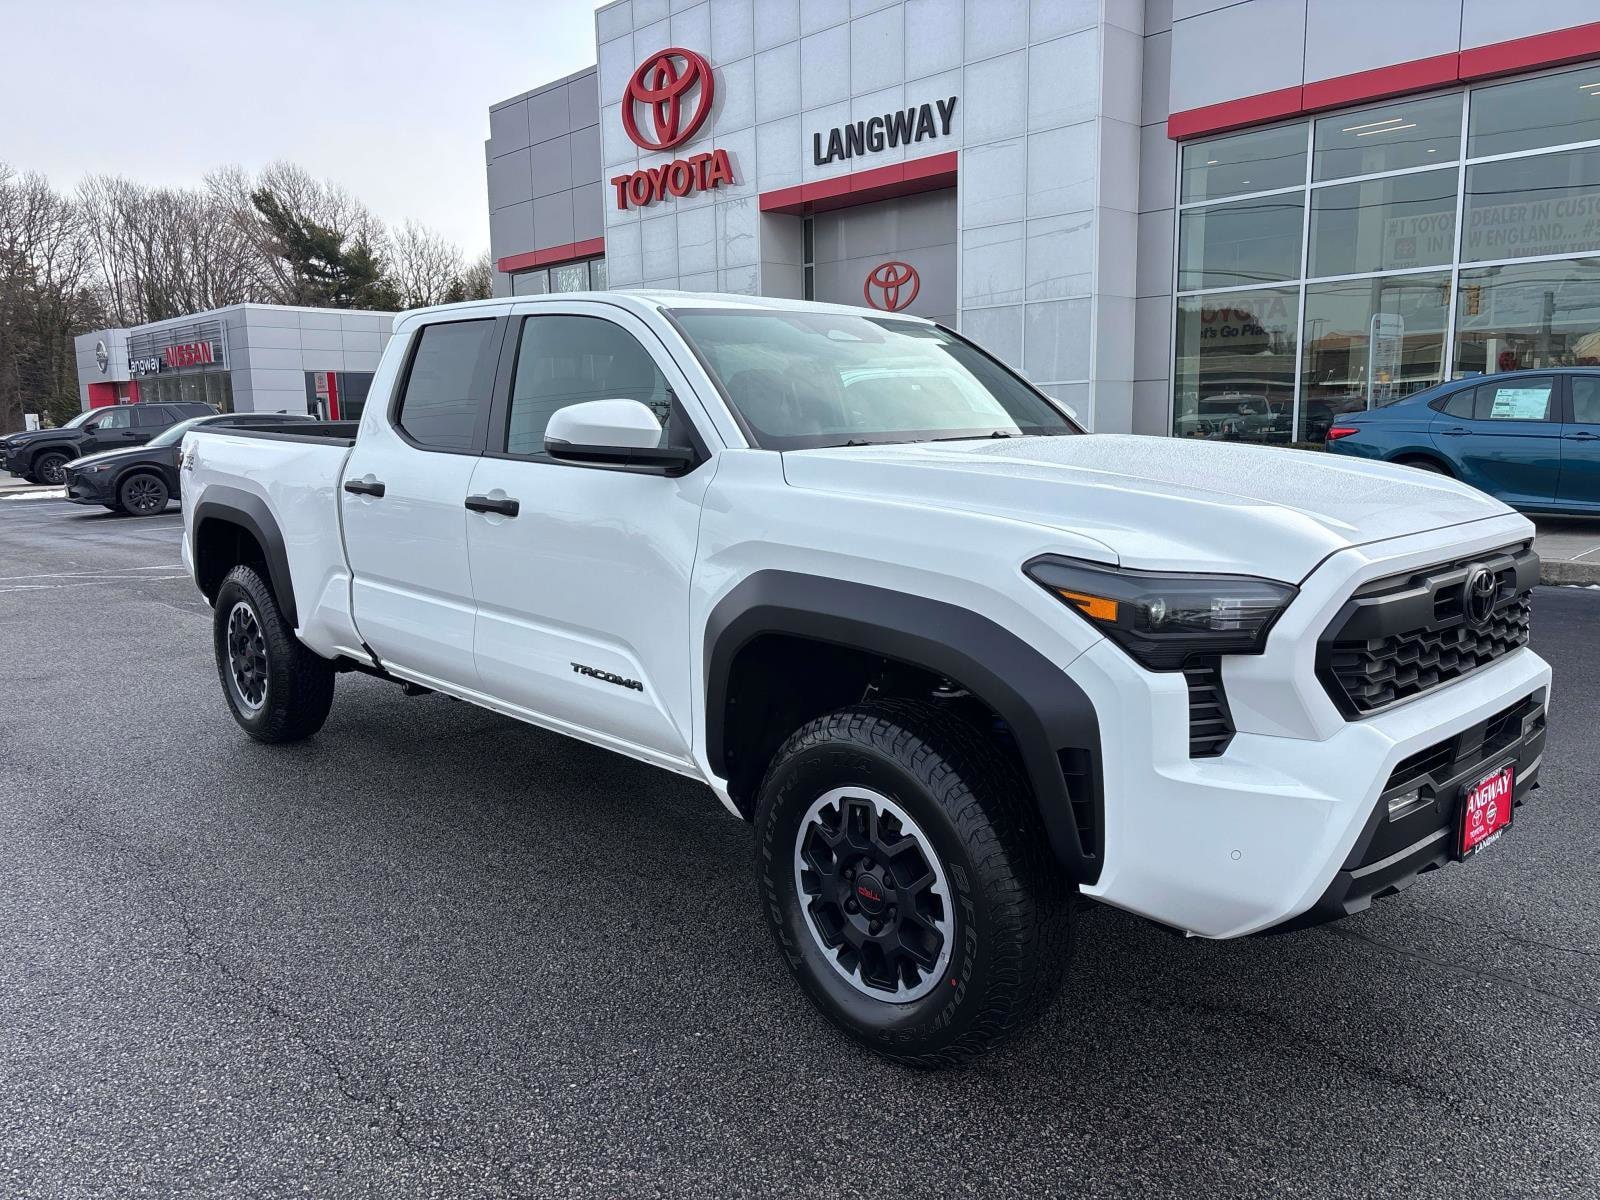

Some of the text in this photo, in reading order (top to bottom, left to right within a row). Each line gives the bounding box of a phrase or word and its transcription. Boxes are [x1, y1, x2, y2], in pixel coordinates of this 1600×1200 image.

[814, 96, 957, 166] LANGWAY
[611, 148, 736, 211] TOYOTA
[1471, 206, 1528, 226] DEALER
[1530, 202, 1552, 220] IN
[1427, 236, 1445, 253] IN
[1220, 325, 1239, 337] Go
[128, 340, 215, 375] Langway NISSAN
[570, 661, 644, 692] TACOMA
[1467, 773, 1511, 817] ANGWAY
[1474, 829, 1503, 854] LANGWAY
